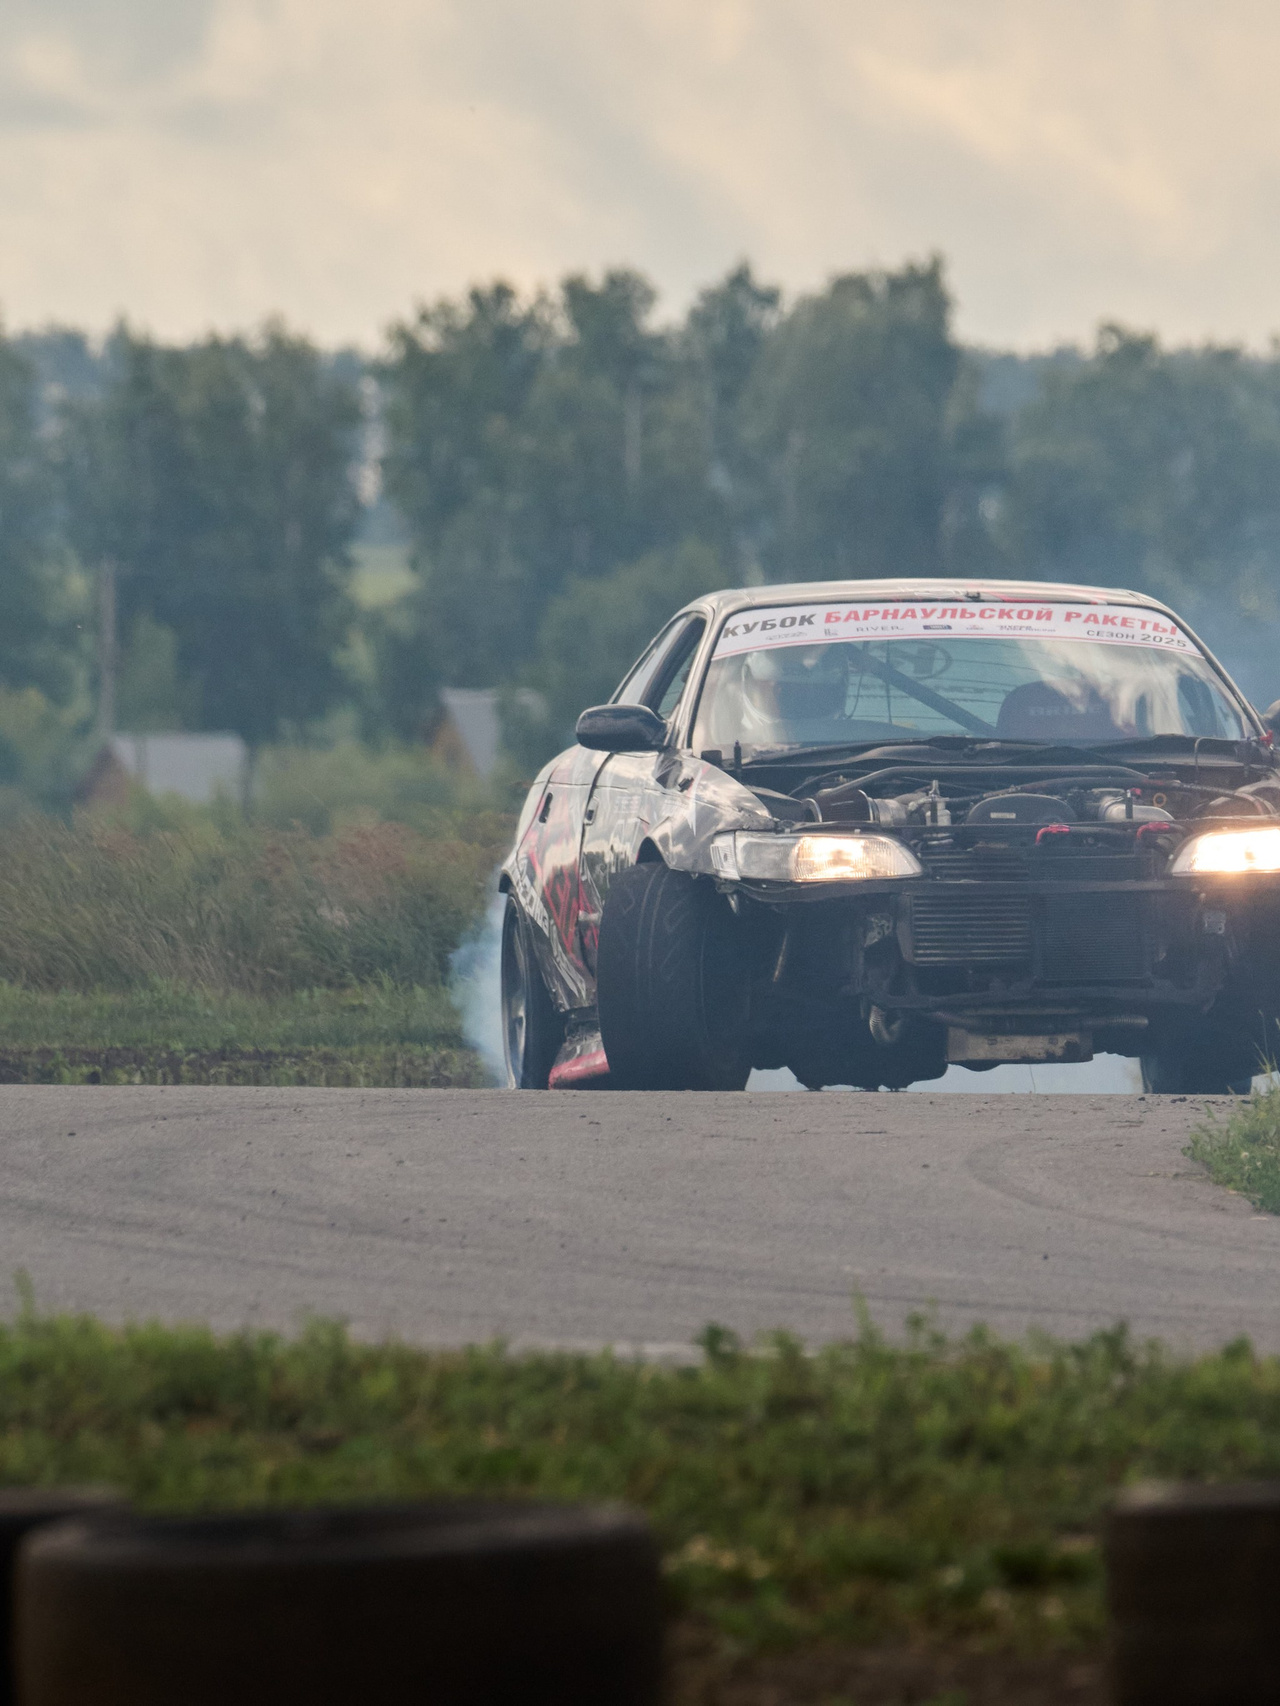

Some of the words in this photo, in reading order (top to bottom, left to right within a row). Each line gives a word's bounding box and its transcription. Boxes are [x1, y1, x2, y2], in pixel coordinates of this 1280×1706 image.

[722, 613, 817, 639] КУБОК
[824, 607, 1054, 624] БАРНАУЛЬСКОЙ
[1064, 611, 1178, 636] РАКЕТЫ
[1087, 629, 1135, 641] СЕЗОН
[1140, 632, 1187, 648] 2025
